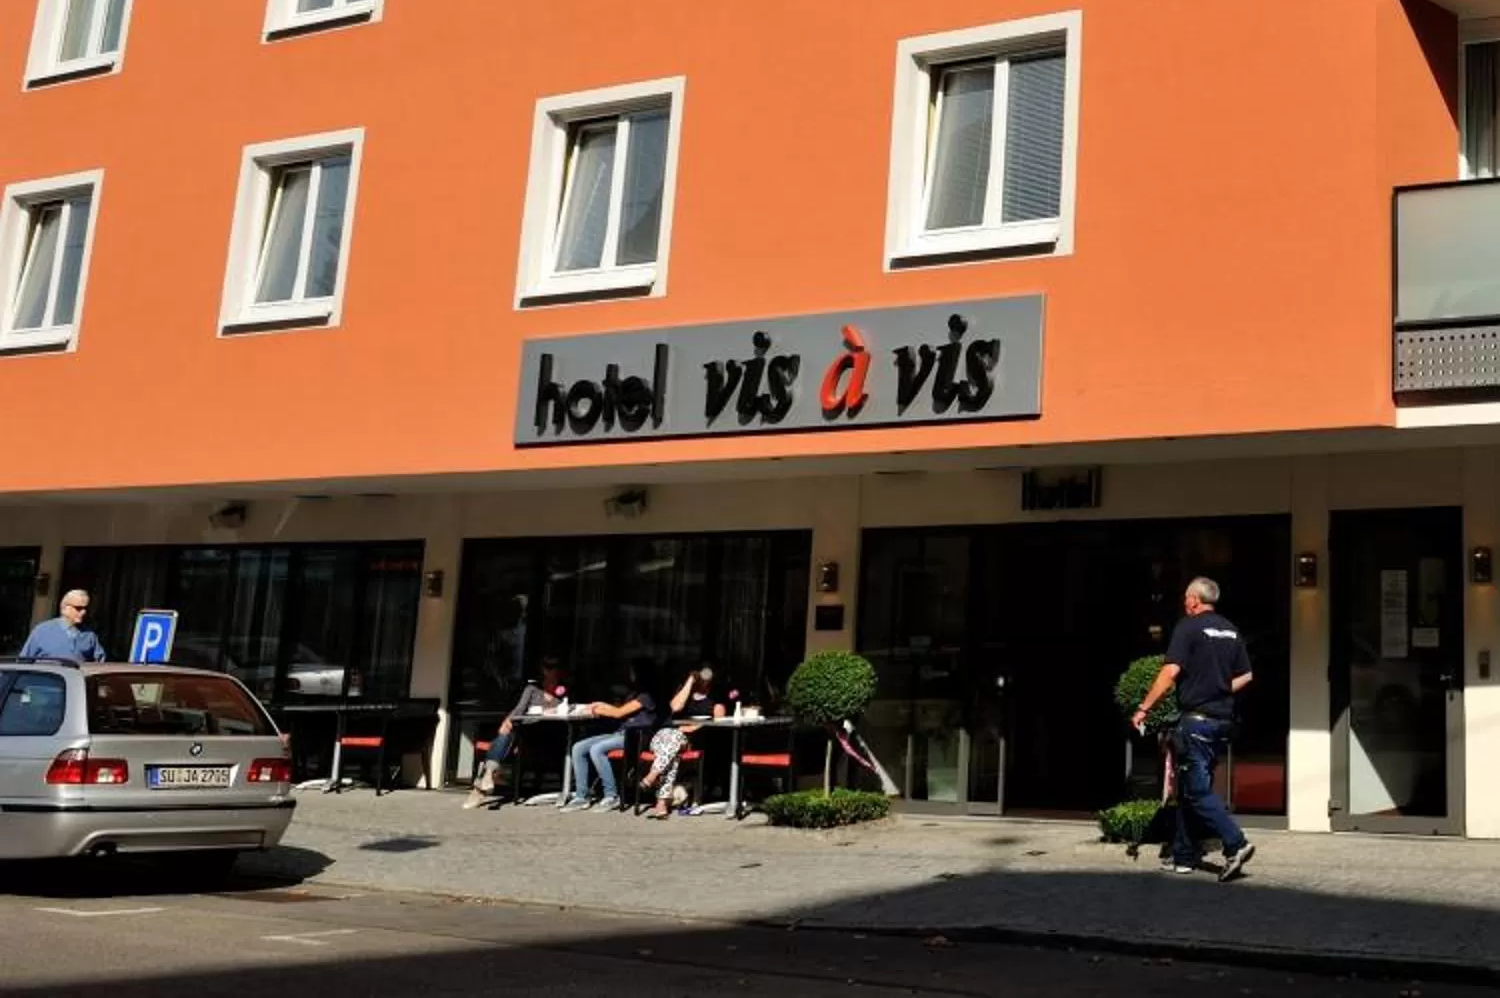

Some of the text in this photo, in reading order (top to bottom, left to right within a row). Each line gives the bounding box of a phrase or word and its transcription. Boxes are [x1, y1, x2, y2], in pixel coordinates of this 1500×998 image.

[534, 314, 1001, 436] hotel vis à vis
[140, 622, 163, 663] P
